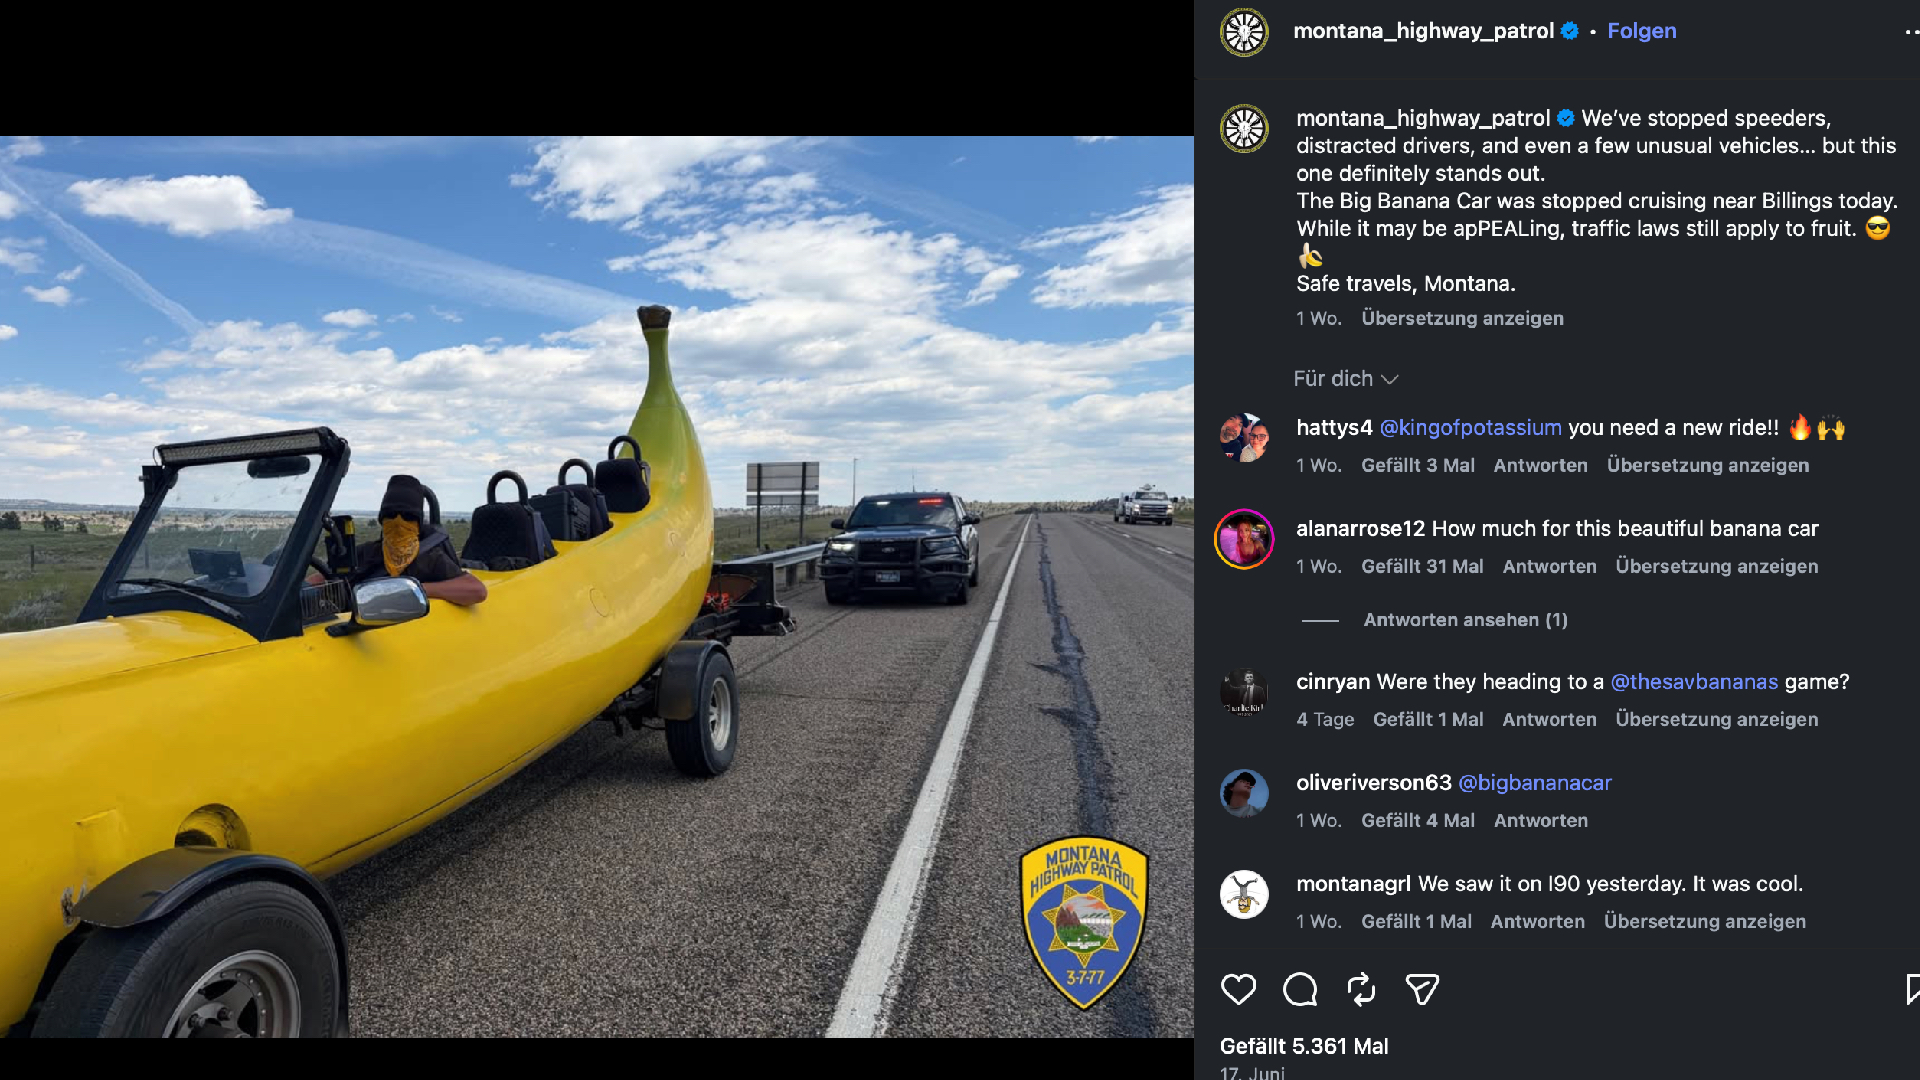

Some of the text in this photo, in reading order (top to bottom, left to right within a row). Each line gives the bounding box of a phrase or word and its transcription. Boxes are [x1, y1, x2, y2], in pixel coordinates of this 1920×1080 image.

[1293, 20, 1555, 44] montana_highway_patrol
[1608, 21, 1677, 43] Folgen
[1296, 108, 1551, 131] montana_highway_patrol
[1647, 108, 1728, 130] stopped
[1734, 108, 1832, 130] speeders,
[1296, 135, 1397, 155] distracted
[1402, 135, 1476, 158] drivers,
[1481, 135, 1519, 155] and
[1524, 140, 1571, 155] even
[1577, 140, 1589, 155] a
[1594, 135, 1631, 155] few
[1636, 135, 1712, 155] unusual
[1822, 135, 1856, 155] but
[1860, 135, 1897, 155] this
[1296, 163, 1546, 186] one definitely stands out.
[1296, 190, 1898, 213] The Big Banana Car was stopped cruising near Billings today.
[1296, 218, 1857, 241] While it may be apPEALing, traffic laws still apply to fruit.
[1296, 273, 1516, 296] Safe travels, Montana.
[1296, 310, 1342, 326] 1 Wo.
[1362, 306, 1565, 329] Übersetzung anzeigen
[1294, 368, 1373, 387] Für dich
[1297, 417, 1779, 441] hattys4 @kingofpotassium you need a new ride!!
[1296, 457, 1342, 473] 1 Wo.
[1361, 456, 1475, 473] Gefällt 3 Mal
[1493, 458, 1588, 473] Antworten
[1607, 453, 1810, 476] Übersetzung anzeigen
[1296, 518, 1820, 538] alanarrose12 How much for this beautiful banana car
[1296, 558, 1342, 574] 1 Wo.
[1361, 557, 1484, 575] Gefällt 31 Mal
[1502, 559, 1597, 574] Antworten
[1616, 554, 1819, 578] Übersetzung anzeigen
[1363, 612, 1568, 631] Antworten ansehen (1)
[1296, 671, 1850, 695] cinryan Were they heading to a @thesavbananas game?
[1296, 711, 1355, 731] 4 Tage
[1373, 710, 1484, 728] Gefällt 1 Mal
[1502, 712, 1597, 727] Antworten
[1616, 707, 1819, 731] Übersetzung anzeigen
[1296, 772, 1613, 795] oliveriverson63 @bigbananacar
[1296, 812, 1342, 828] 1 Wo.
[1361, 811, 1475, 829] Gefällt 4 Mal
[1493, 813, 1589, 828] Antworten
[1296, 873, 1803, 896] montanagrl We saw it on I90 yesterday. It was cool.
[1296, 913, 1342, 929] 1 Wo.
[1361, 912, 1472, 930] Gefällt 1 Mal
[1490, 914, 1586, 929] Antworten
[1604, 909, 1807, 933] Übersetzung anzeigen
[1220, 1037, 1389, 1055] Gefällt 5.361 Mal
[1248, 1066, 1285, 1080] Juni
